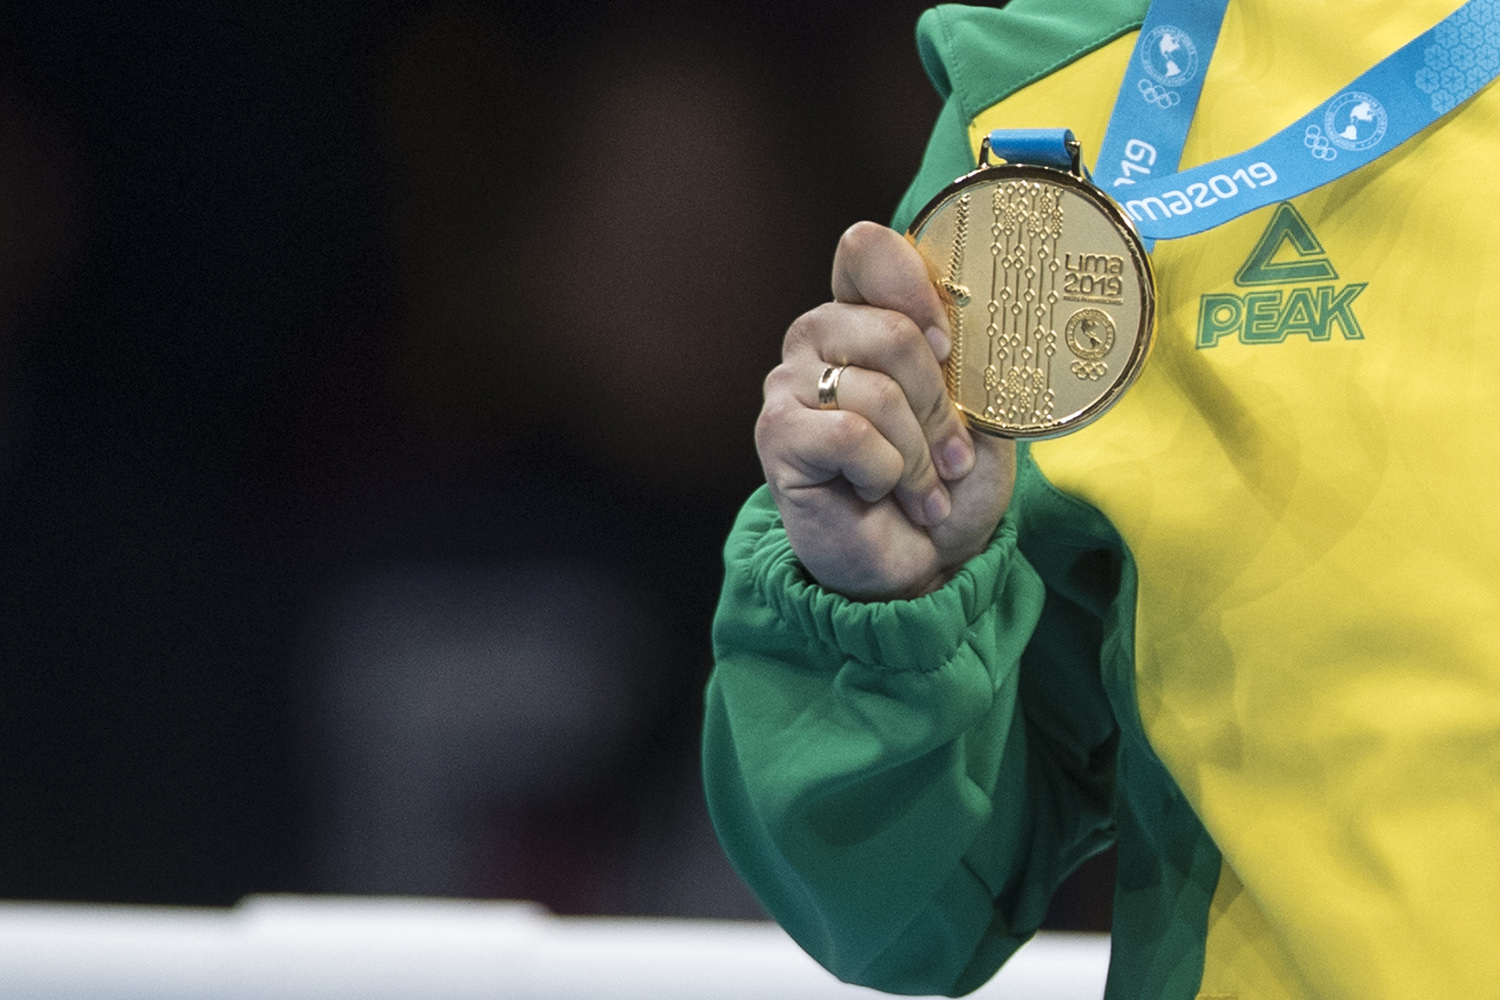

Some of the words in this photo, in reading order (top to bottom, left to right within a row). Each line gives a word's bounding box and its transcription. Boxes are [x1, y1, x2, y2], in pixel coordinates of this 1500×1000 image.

[1117, 161, 1279, 222] ima2019
[1063, 271, 1123, 297] 2019
[1195, 281, 1370, 350] PEAK
